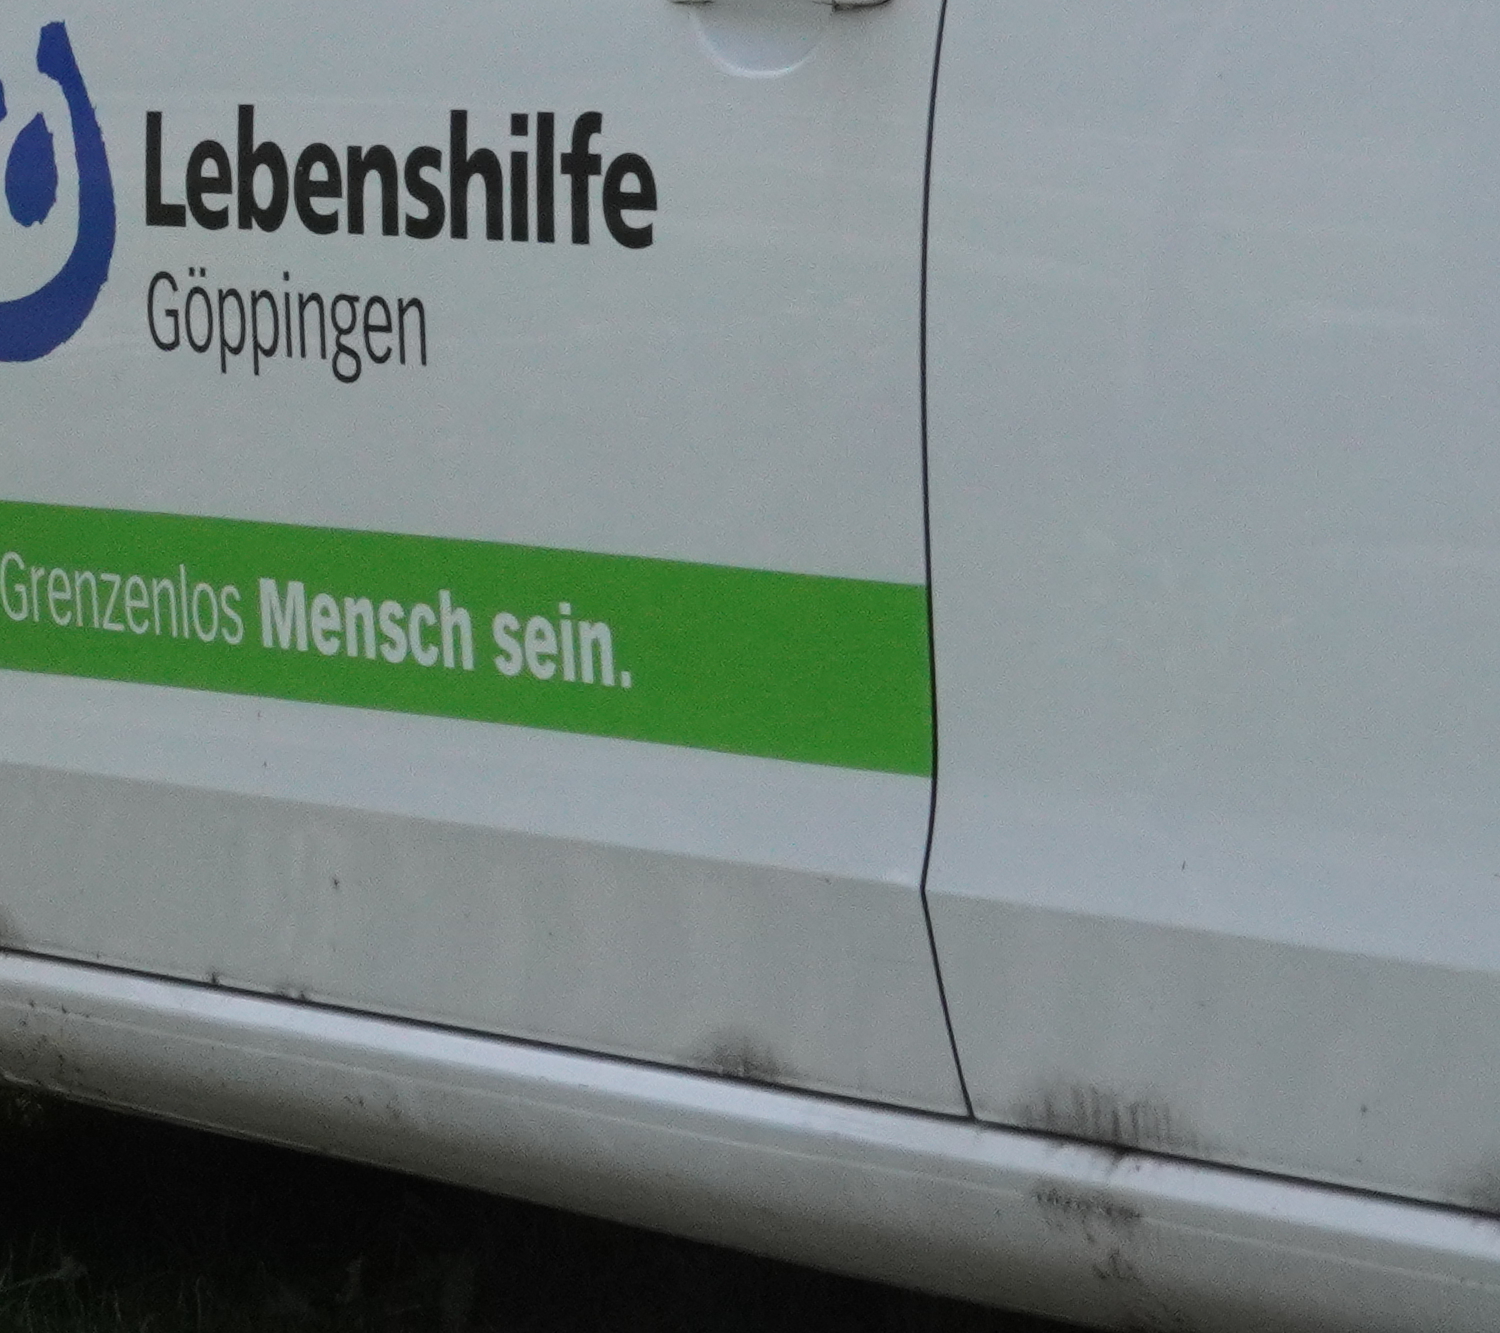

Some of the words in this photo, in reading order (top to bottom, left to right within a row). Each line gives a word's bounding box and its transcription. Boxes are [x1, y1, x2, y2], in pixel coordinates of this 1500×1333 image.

[145, 104, 658, 250] Lebenshilfe
[147, 266, 427, 384] Göppingen
[0, 551, 244, 645] Grenzenlos
[258, 577, 474, 671] Mensch
[491, 601, 632, 689] sein.
